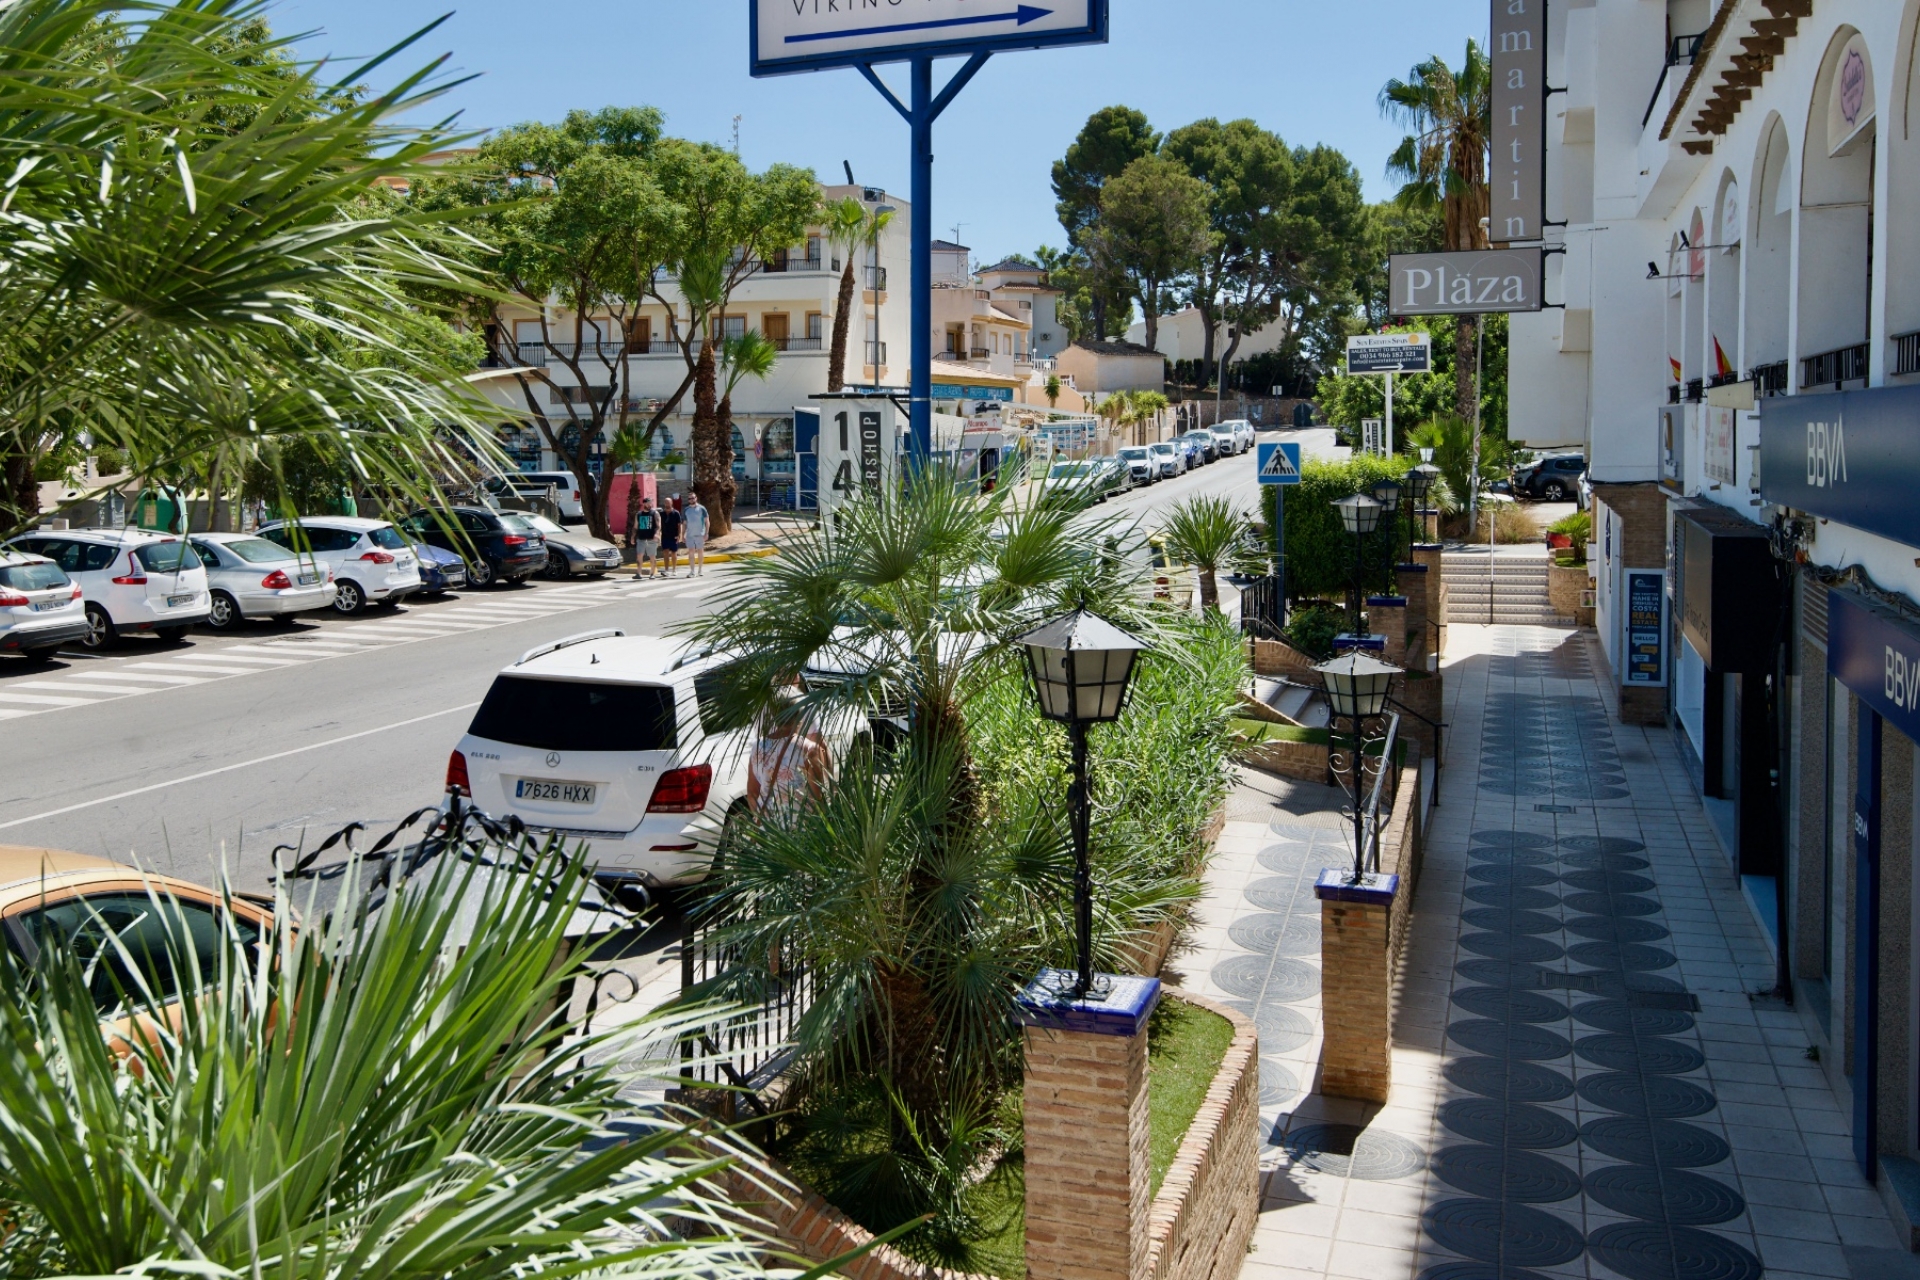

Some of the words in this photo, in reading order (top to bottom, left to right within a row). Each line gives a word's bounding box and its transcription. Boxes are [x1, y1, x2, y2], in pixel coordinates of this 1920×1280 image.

[1807, 412, 1848, 488] BBVA
[1632, 611, 1658, 619] REAL
[524, 782, 560, 799] 7626
[563, 785, 591, 802] HXX
